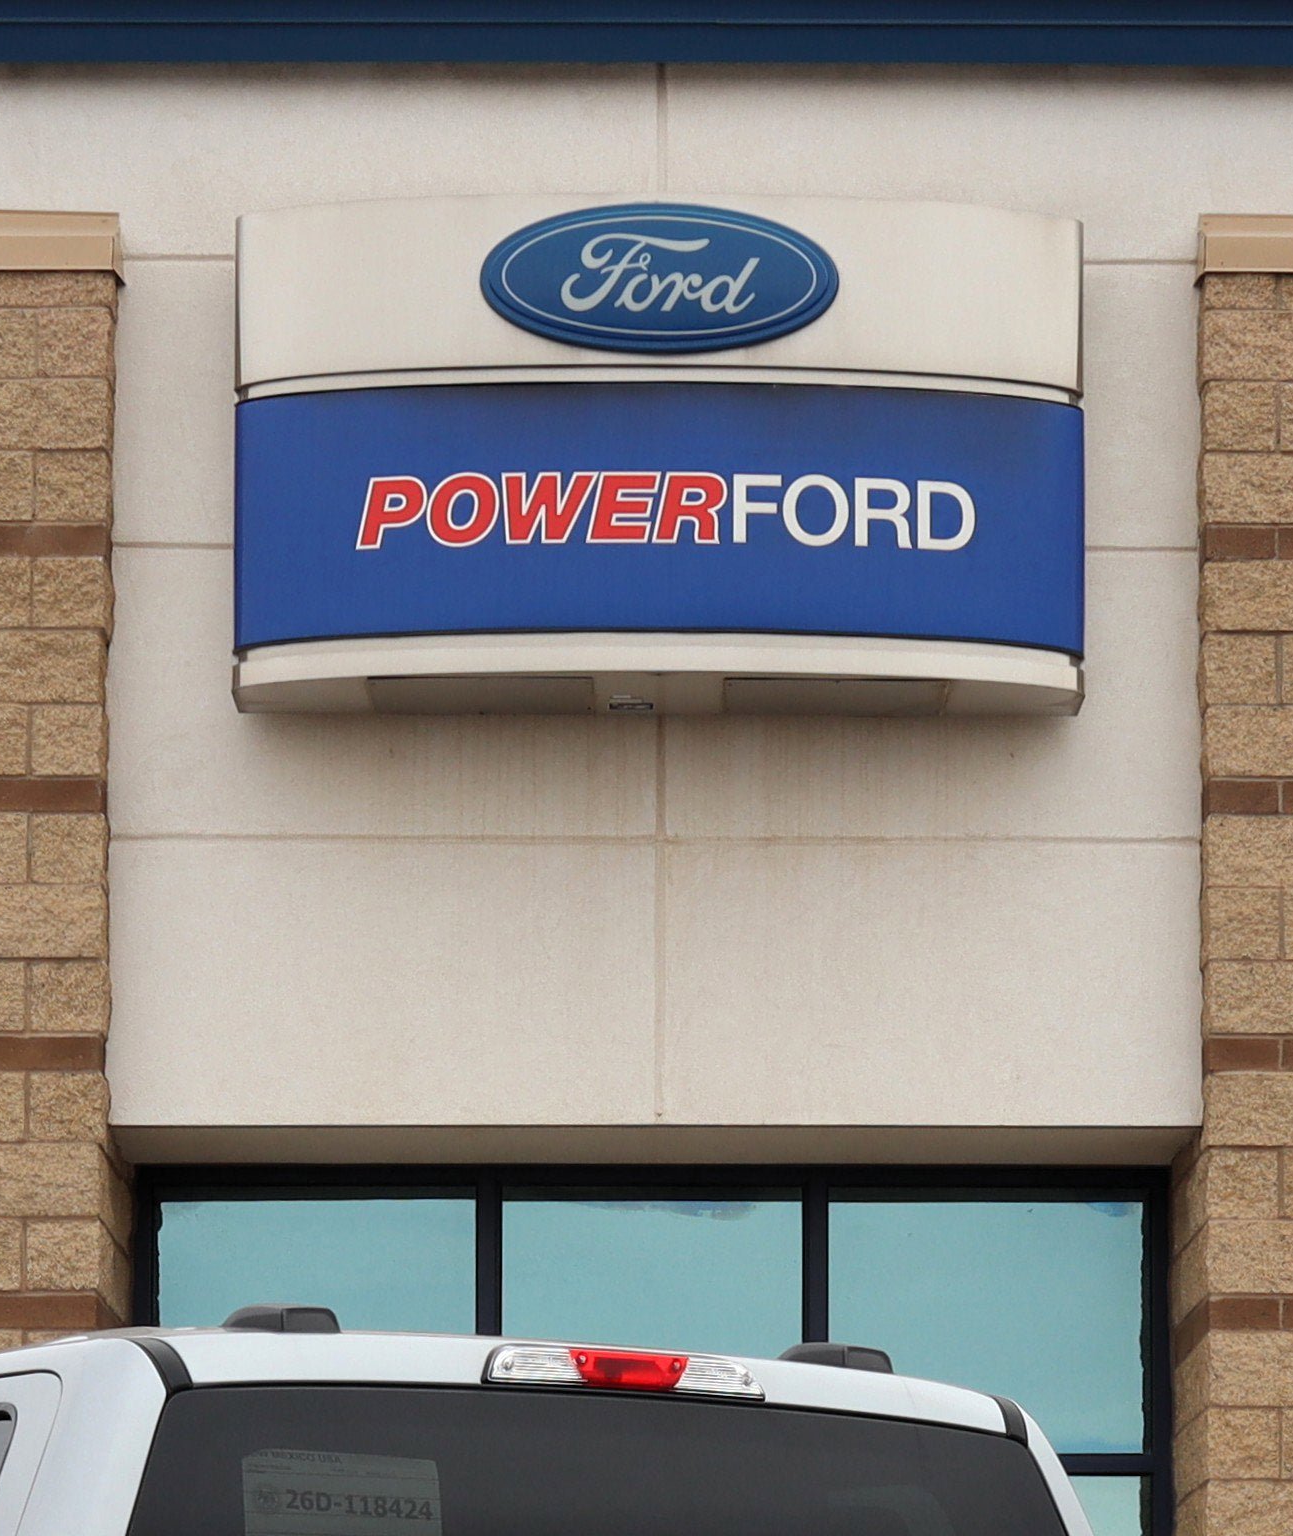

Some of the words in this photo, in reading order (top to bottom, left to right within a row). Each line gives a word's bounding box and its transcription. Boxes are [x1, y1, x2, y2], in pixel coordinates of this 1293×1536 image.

[560, 232, 760, 315] Ford
[355, 471, 977, 551] POWERFORD
[285, 1488, 433, 1520] 26D-118424
